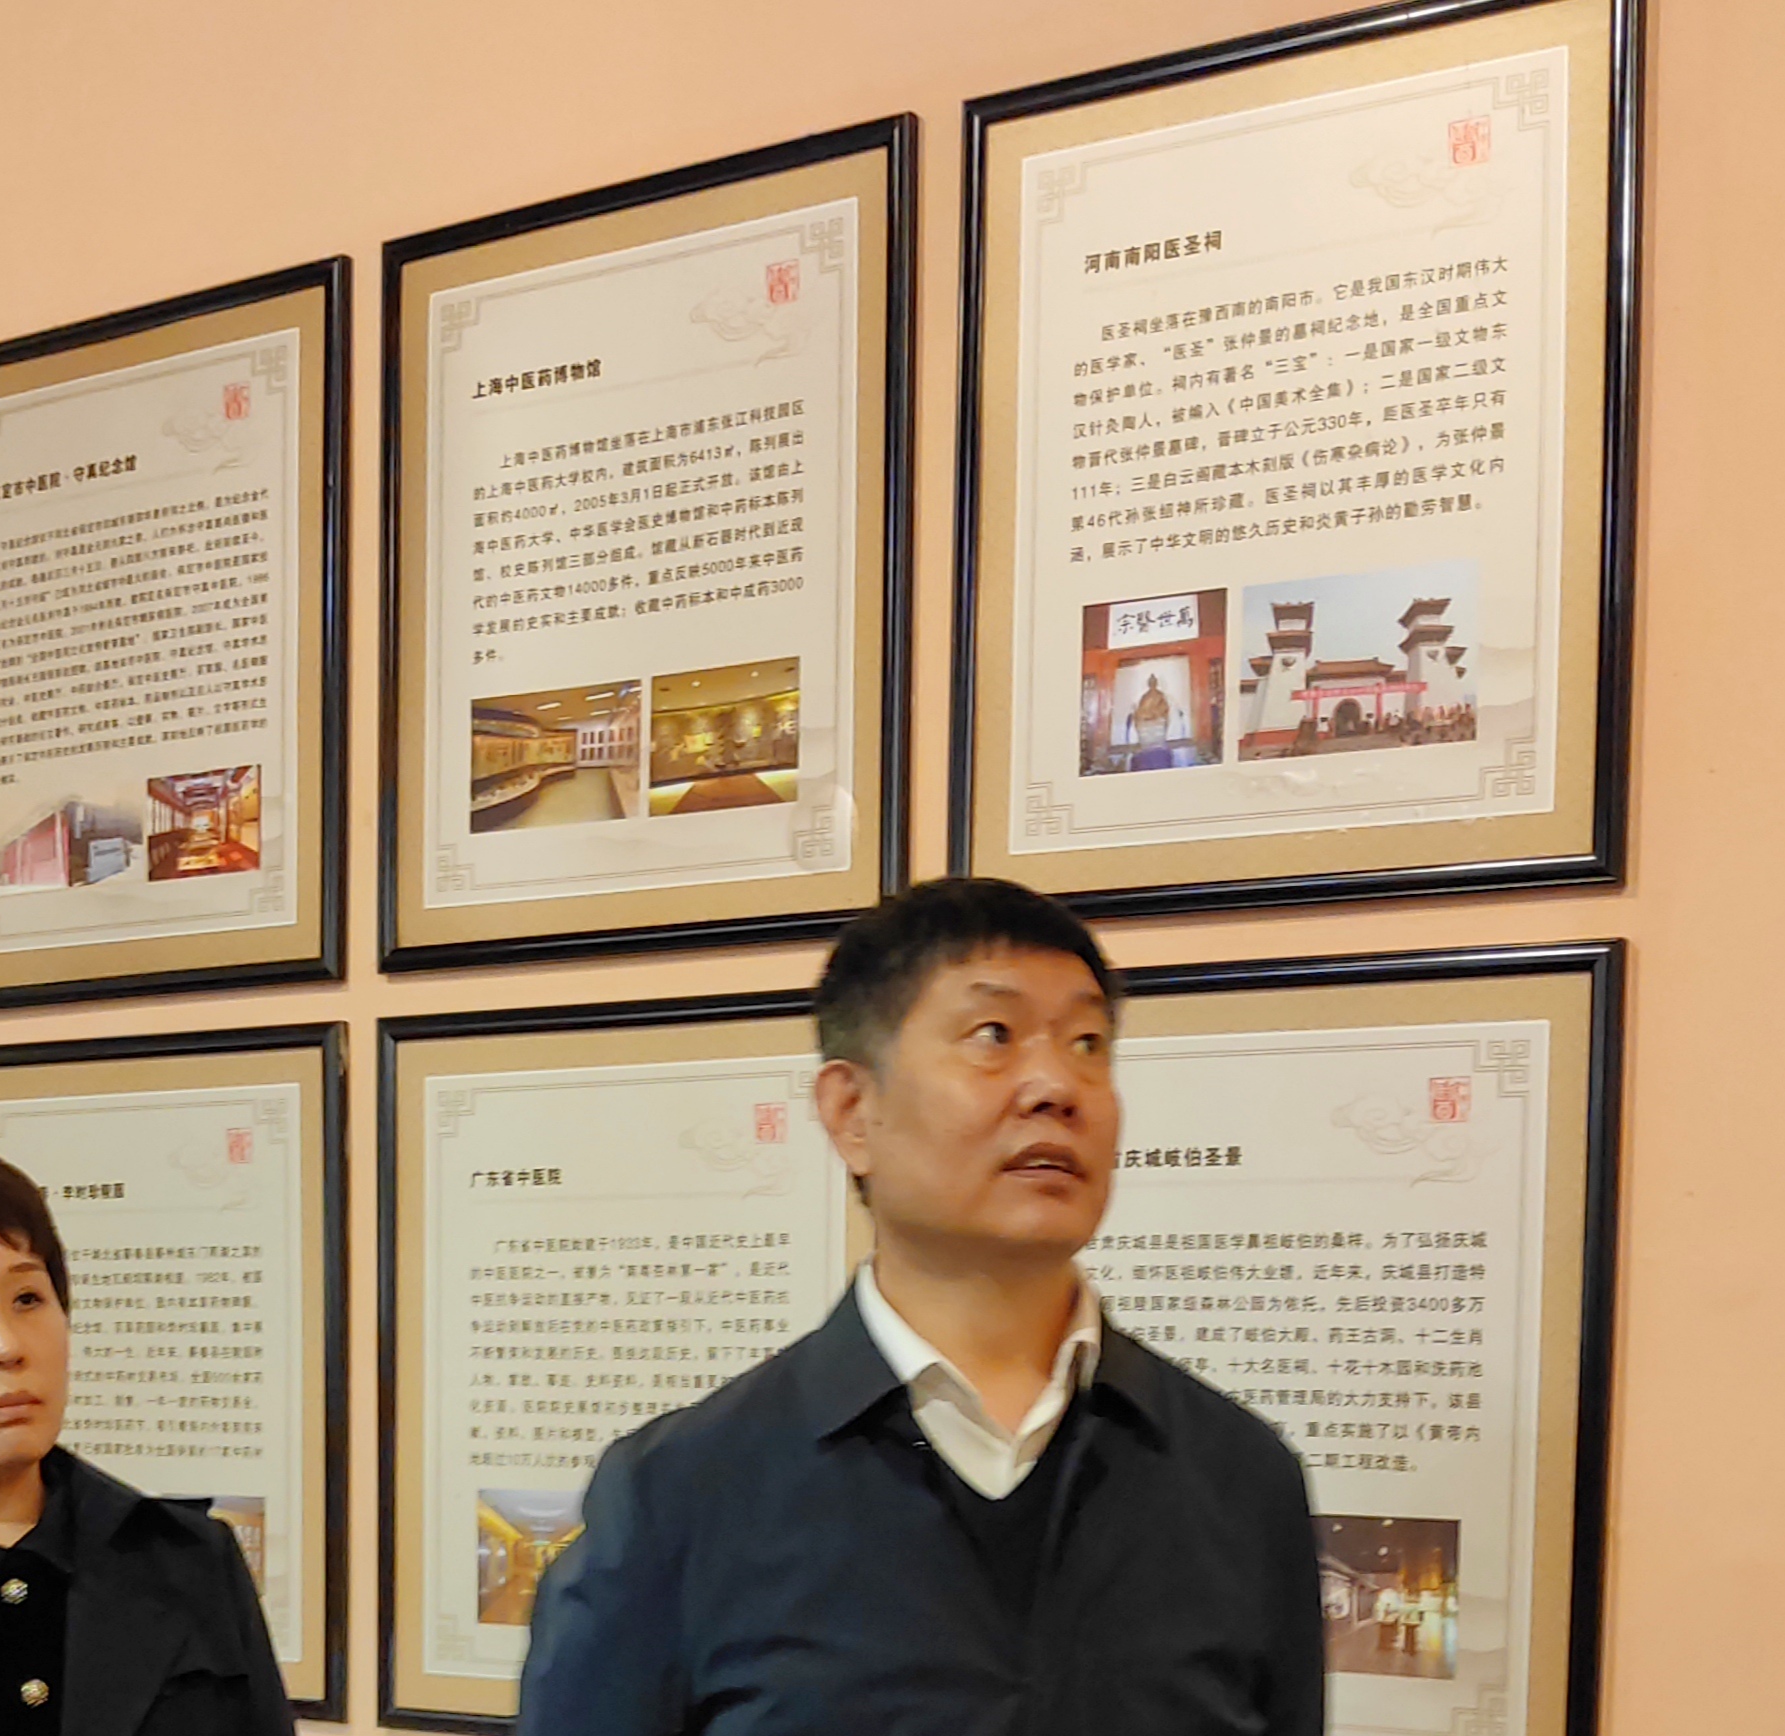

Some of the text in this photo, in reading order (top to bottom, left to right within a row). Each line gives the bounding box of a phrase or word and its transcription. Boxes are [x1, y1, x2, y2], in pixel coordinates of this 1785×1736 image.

[1085, 231, 1222, 274] 河南南阳医圣祠
[472, 359, 602, 399] 上海中医药博物馆
[470, 1168, 562, 1188] 广东省中医院
